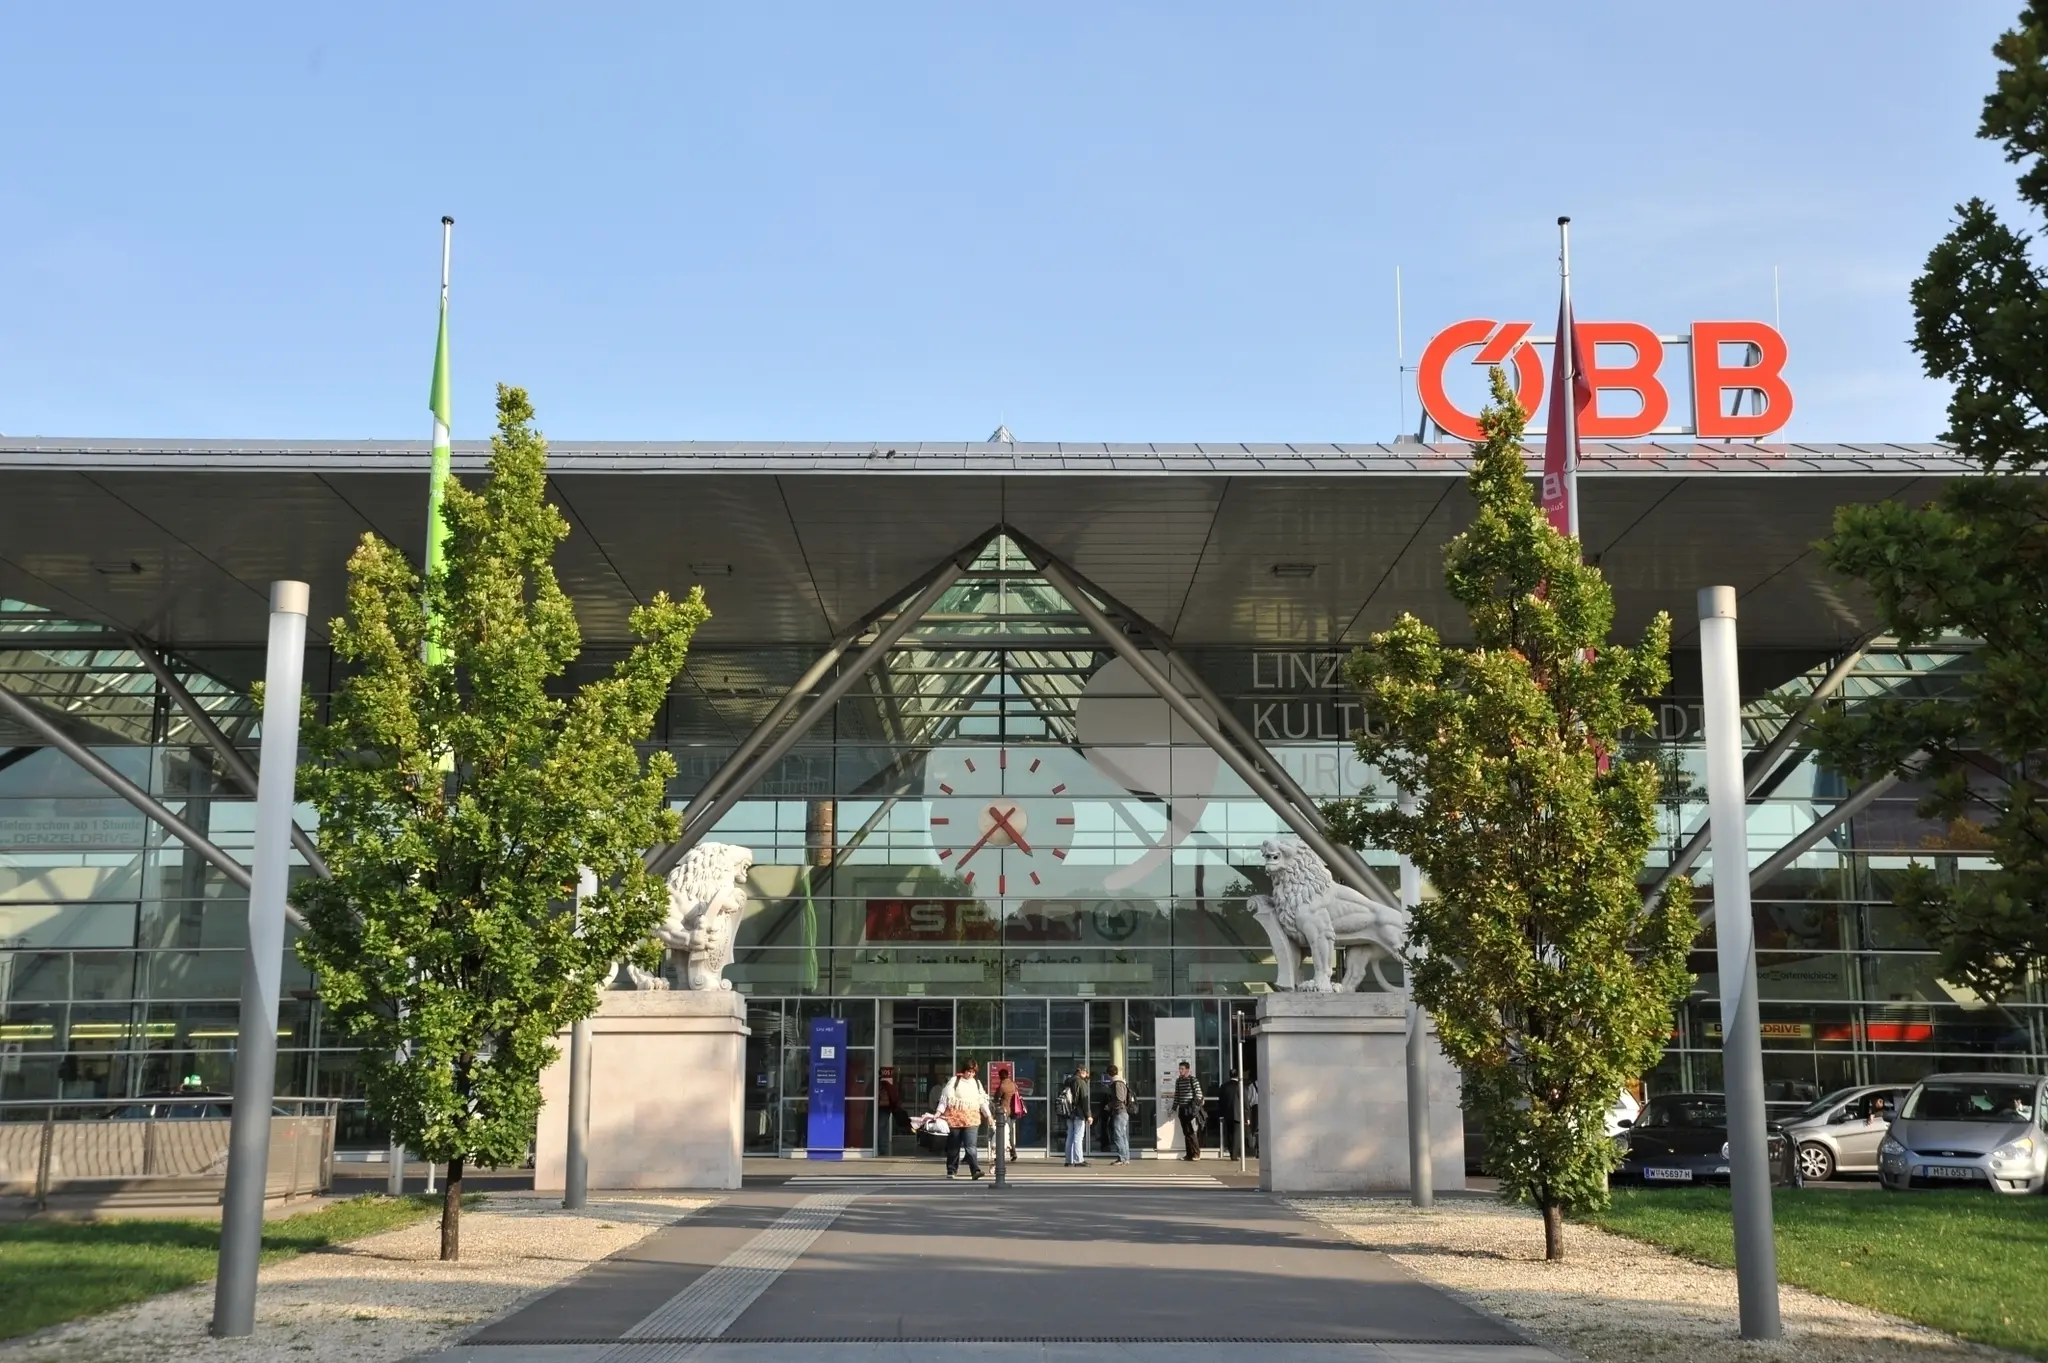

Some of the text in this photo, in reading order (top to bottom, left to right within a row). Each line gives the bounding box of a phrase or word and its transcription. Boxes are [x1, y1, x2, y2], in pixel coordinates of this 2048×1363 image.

[1417, 319, 1794, 442] ÖBB
[1252, 652, 1345, 689] LINZ
[74, 819, 88, 832] ab
[910, 904, 1077, 932] SPAR
